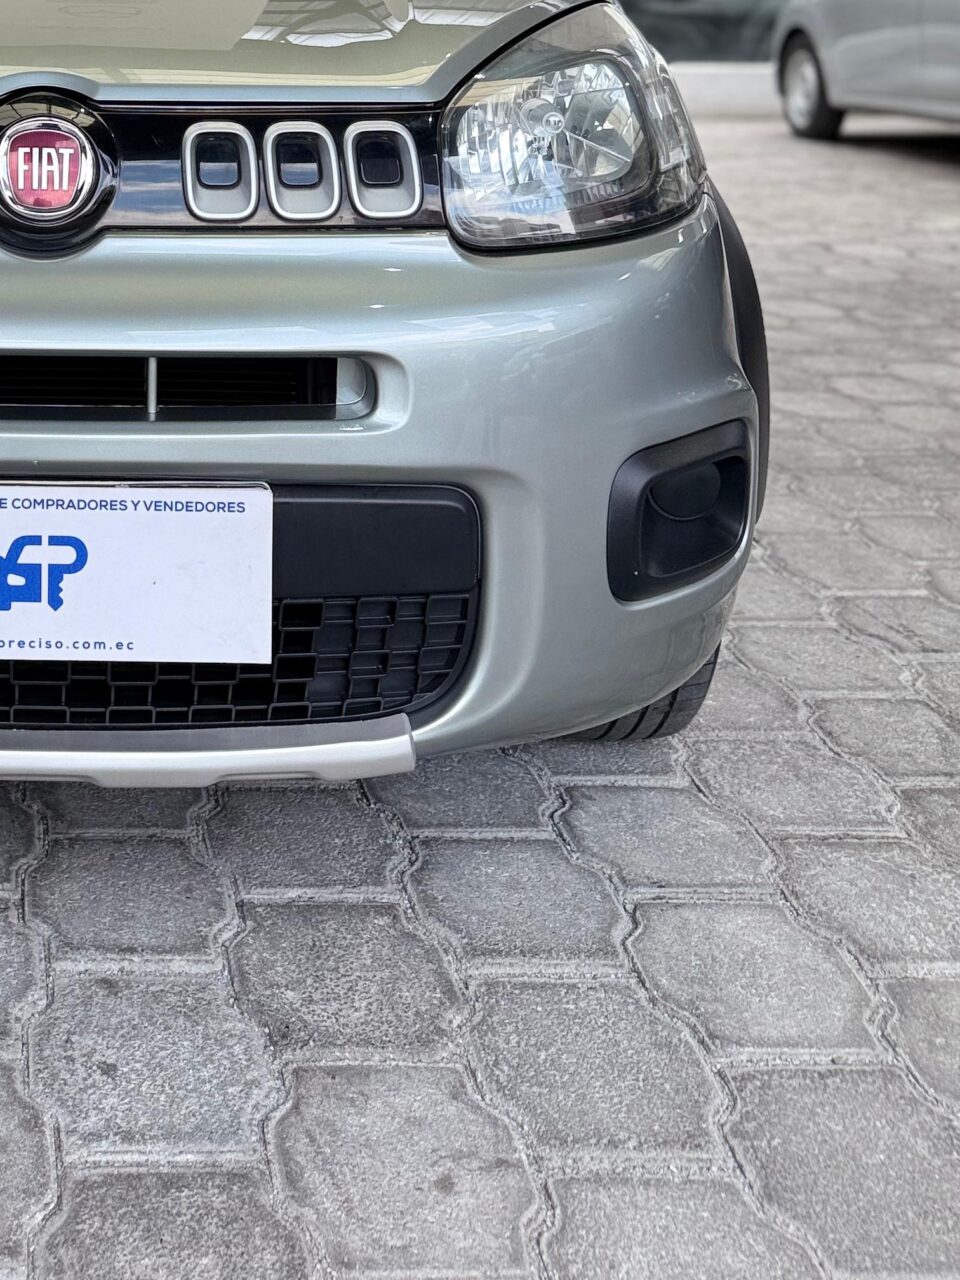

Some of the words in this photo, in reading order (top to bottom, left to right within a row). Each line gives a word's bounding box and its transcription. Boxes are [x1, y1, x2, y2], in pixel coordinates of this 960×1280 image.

[16, 146, 75, 191] FIAT
[11, 497, 128, 512] COMPRADORES
[130, 500, 141, 512] Y
[143, 500, 246, 514] VENDEDORES
